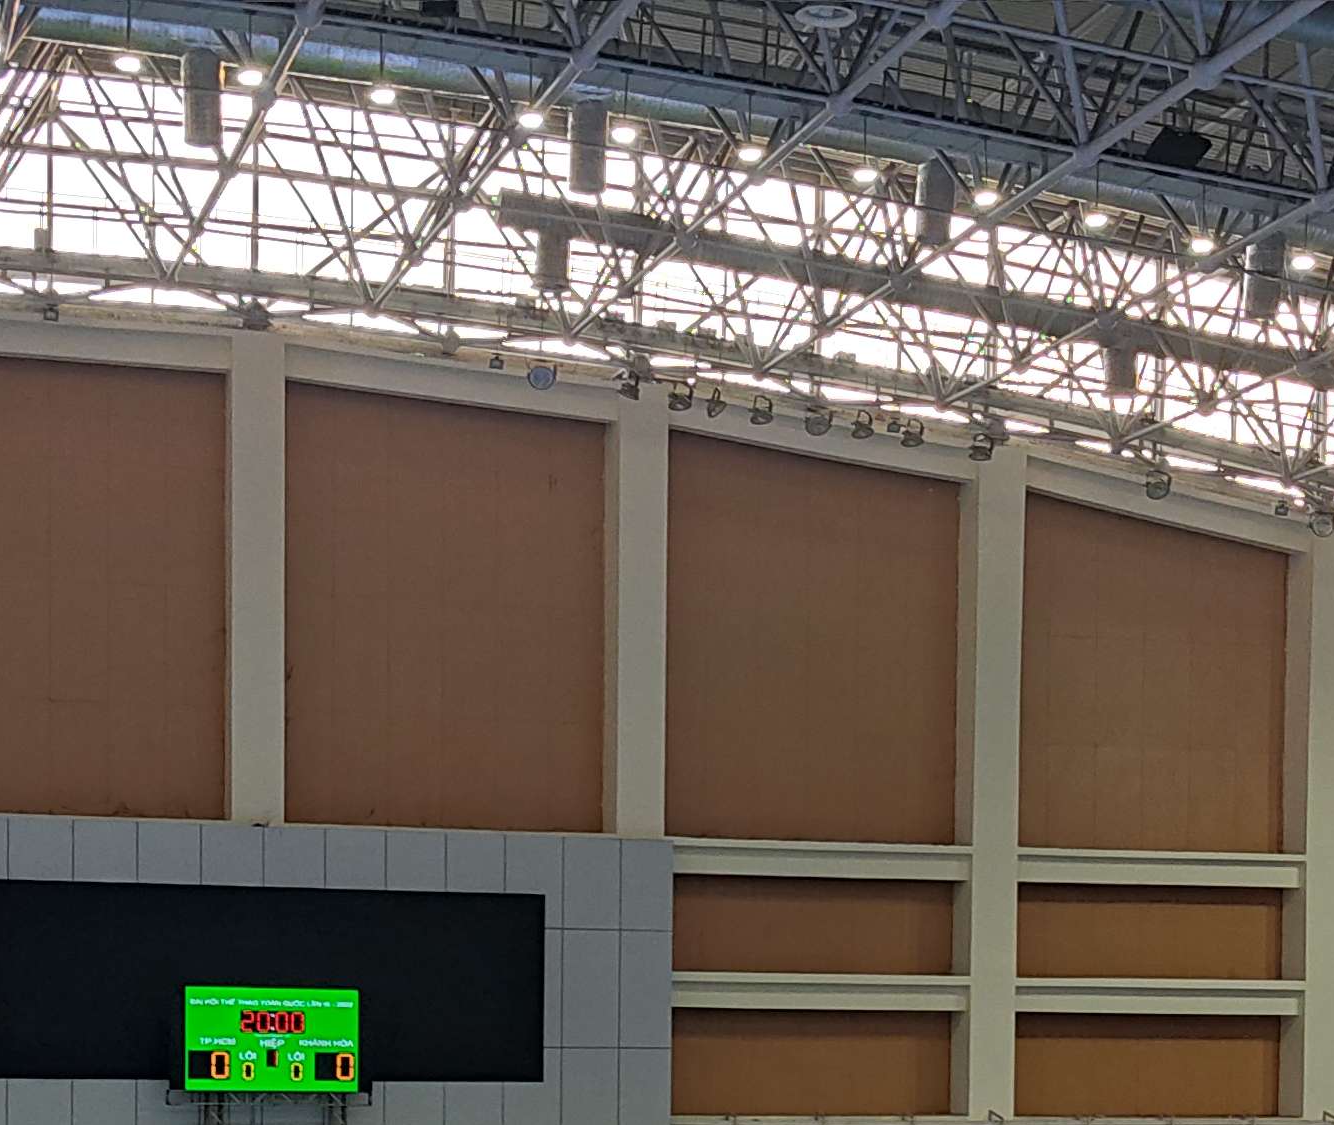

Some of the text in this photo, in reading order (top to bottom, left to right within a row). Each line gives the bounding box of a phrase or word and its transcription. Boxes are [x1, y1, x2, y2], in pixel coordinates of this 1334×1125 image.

[240, 1010, 305, 1034] 20:00
[211, 1051, 230, 1080] 0
[242, 1061, 255, 1081] 0
[290, 1062, 304, 1082] 0
[335, 1053, 355, 1082] 0
